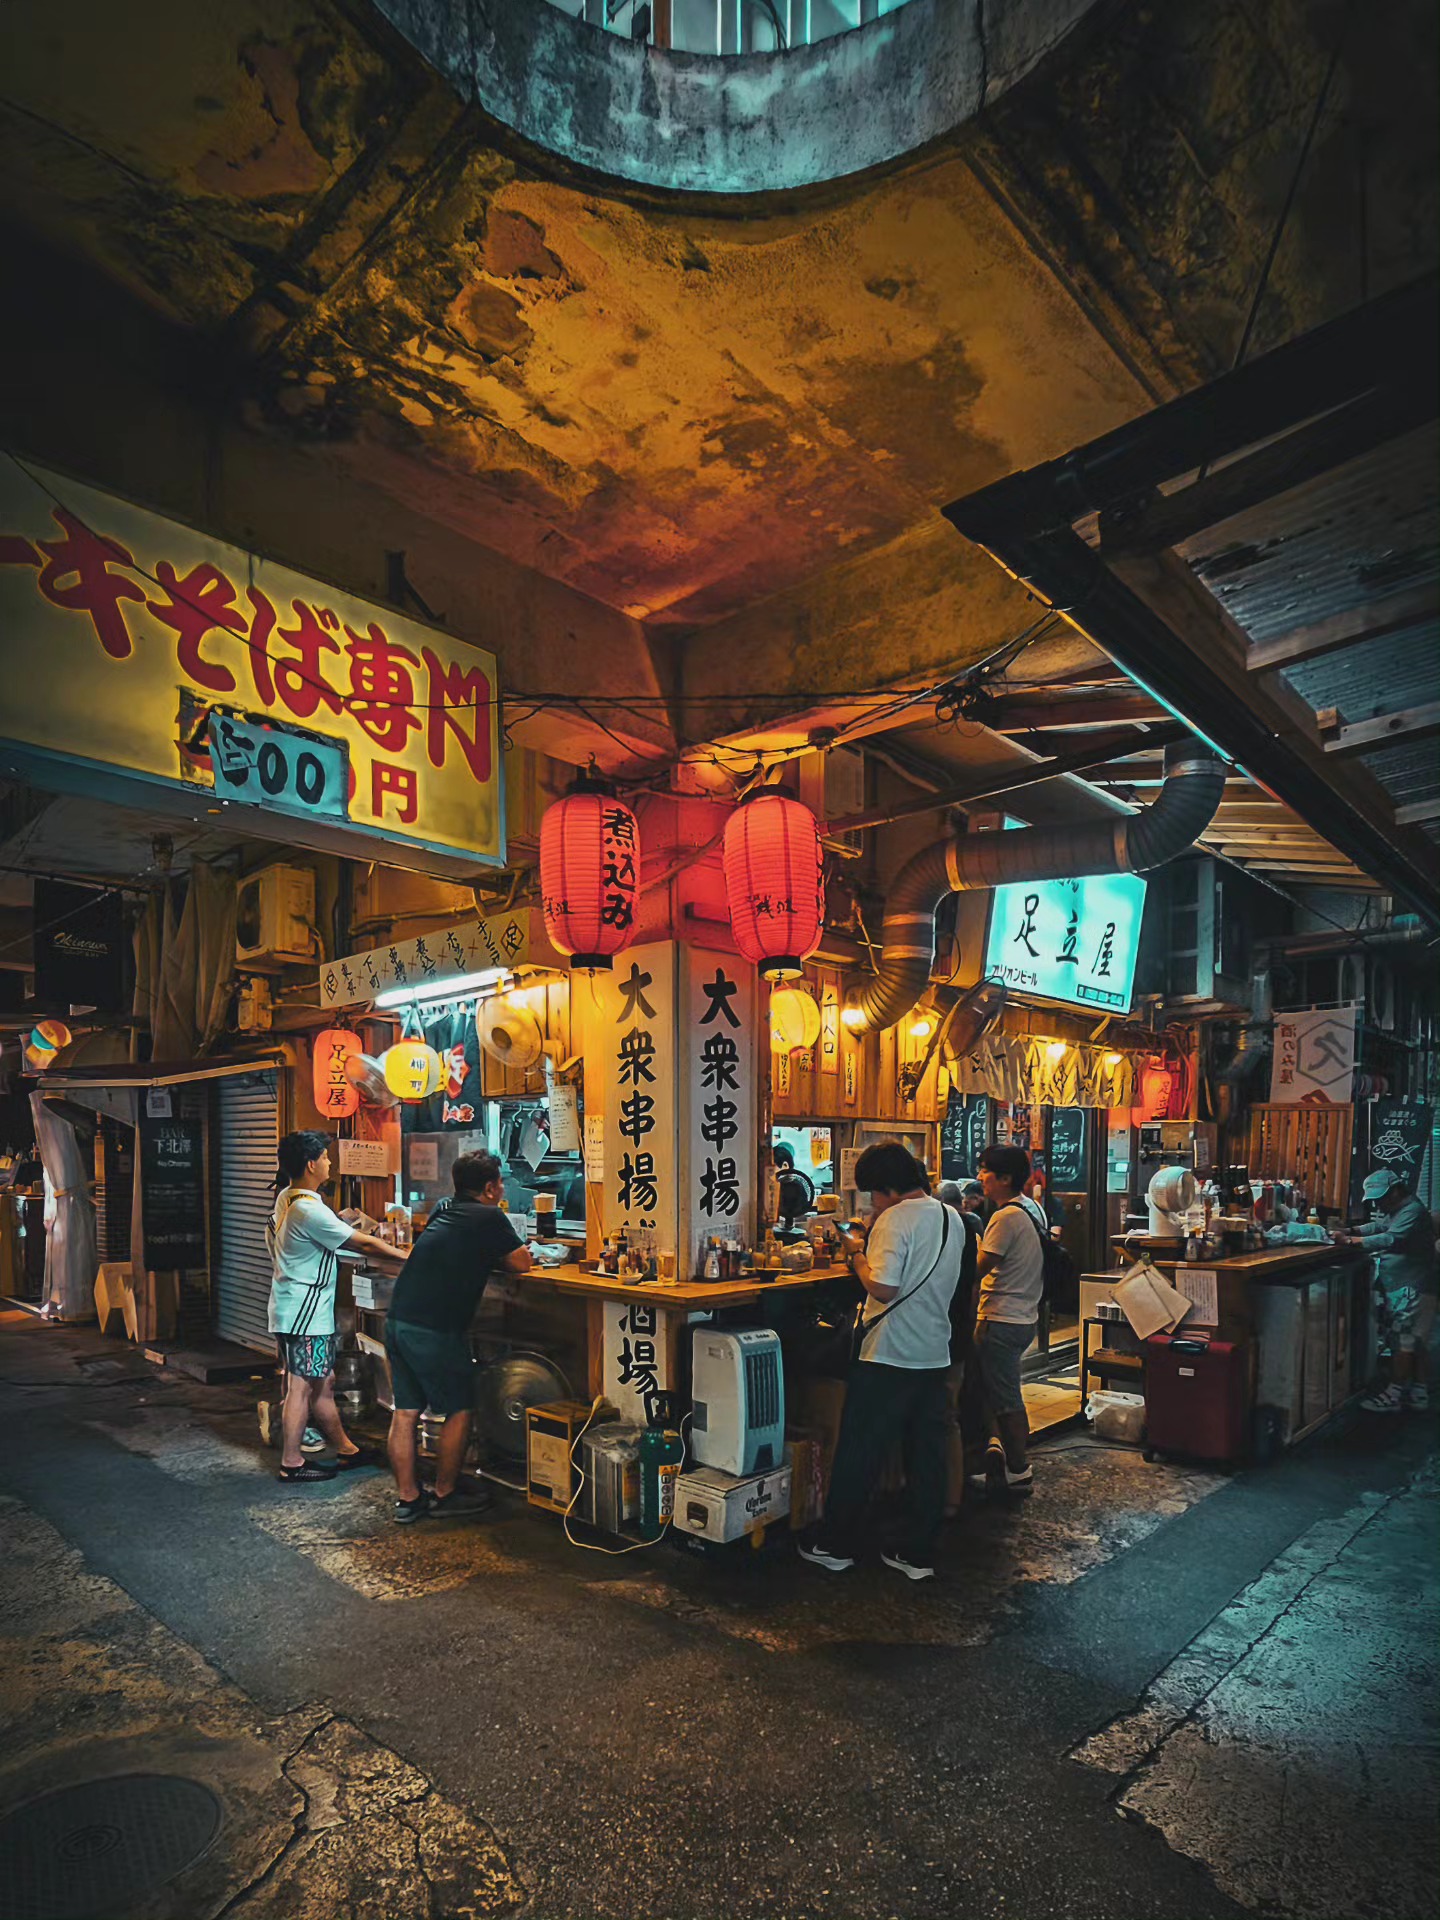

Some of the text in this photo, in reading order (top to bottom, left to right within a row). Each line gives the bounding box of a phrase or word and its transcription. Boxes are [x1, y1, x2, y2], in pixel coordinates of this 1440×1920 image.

[602, 808, 637, 930] 煮込み
[1013, 893, 1116, 977] 足立屋
[327, 1044, 347, 1107] 足立屋
